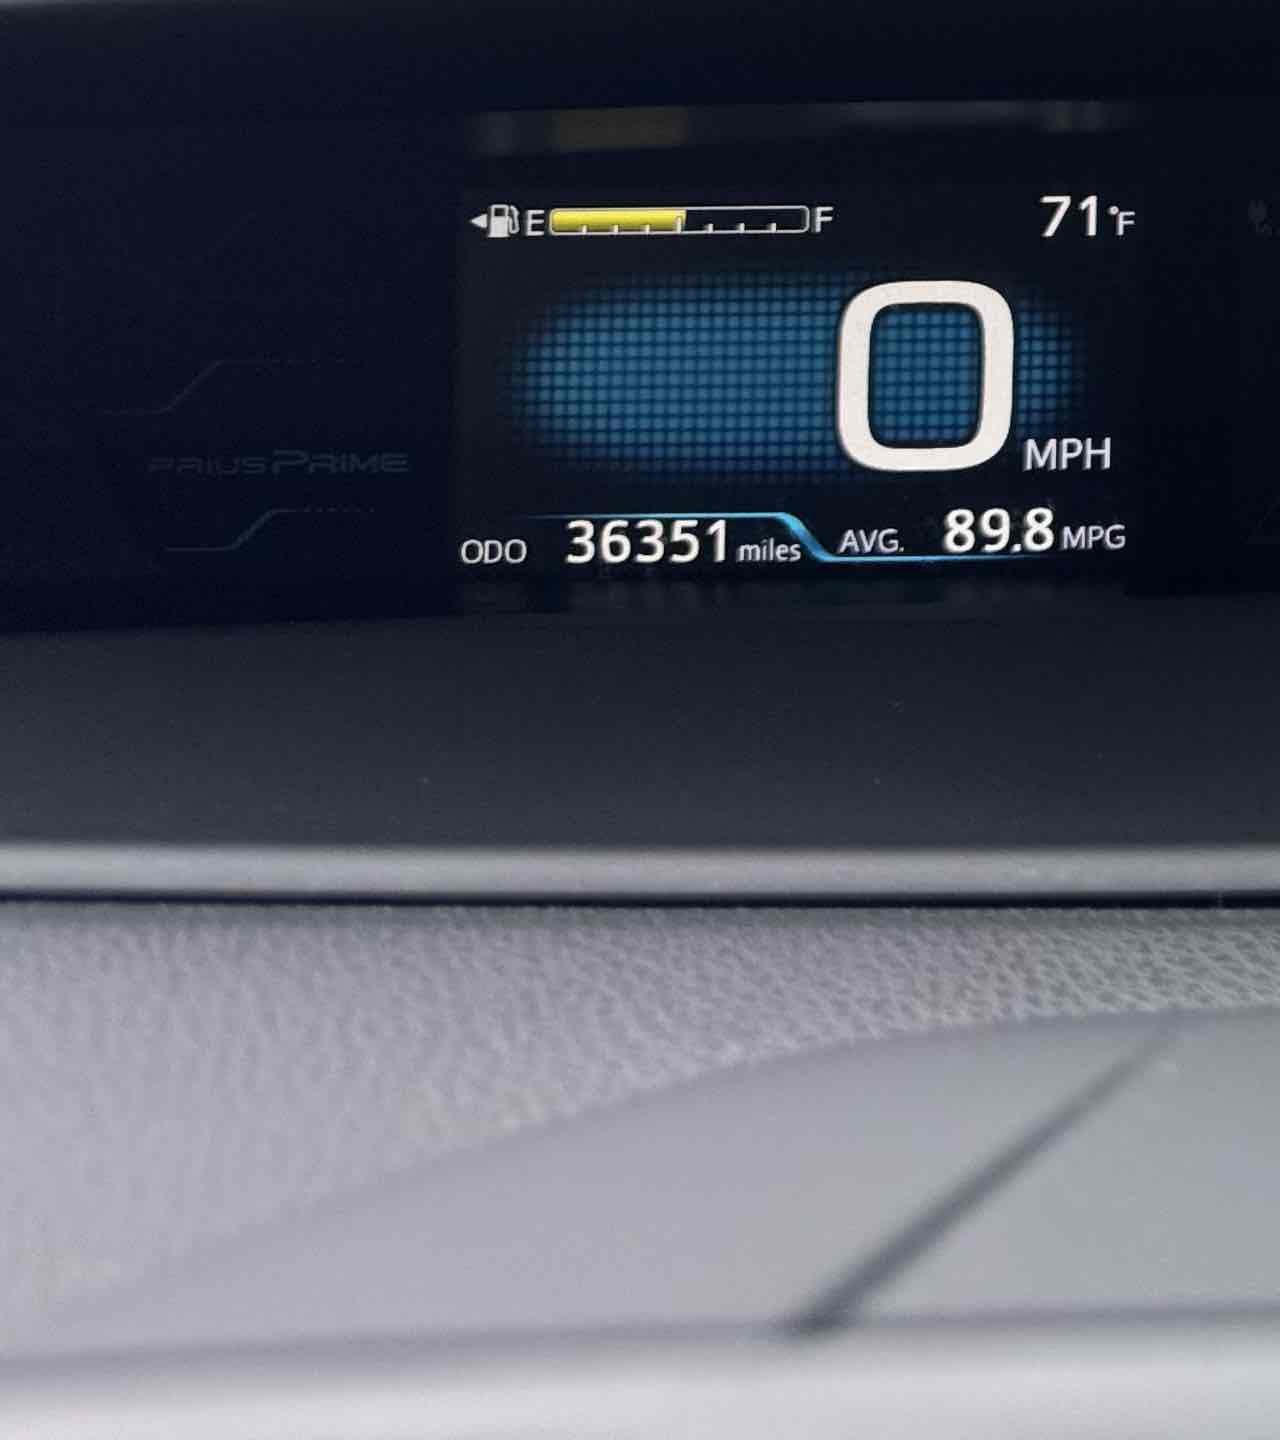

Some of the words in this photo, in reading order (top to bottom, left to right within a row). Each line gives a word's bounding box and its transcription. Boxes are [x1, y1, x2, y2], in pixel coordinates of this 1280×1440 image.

[525, 209, 545, 237] E
[814, 206, 834, 233] F
[839, 280, 1014, 471] 0
[1025, 436, 1112, 471] MPH
[460, 538, 527, 564] ODO
[567, 519, 726, 564] 36351
[738, 537, 802, 562] miles
[839, 528, 905, 554] AVG.
[945, 507, 1054, 553] 89.8
[1062, 523, 1126, 550] MPG
